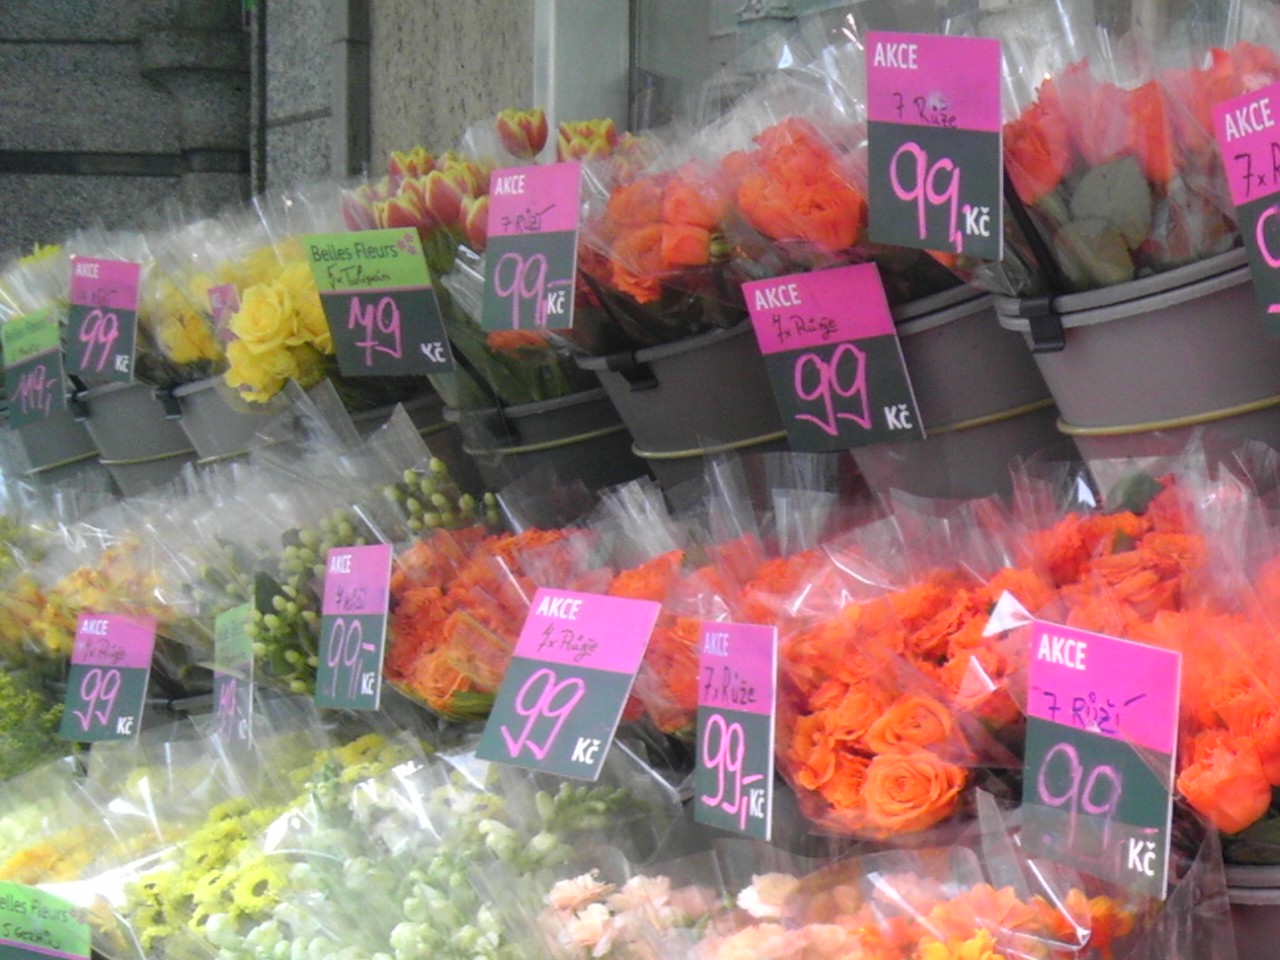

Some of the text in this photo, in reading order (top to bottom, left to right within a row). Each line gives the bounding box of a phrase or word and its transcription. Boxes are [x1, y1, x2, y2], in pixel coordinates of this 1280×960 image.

[874, 43, 918, 69] AKCE
[892, 92, 905, 118] 7
[1225, 98, 1275, 141] AKCE
[495, 175, 525, 195] AKCE
[1234, 153, 1265, 197] 7x
[966, 207, 990, 236] Kč
[311, 242, 398, 262] Belles Fleurs
[547, 291, 565, 315] Kč
[755, 284, 801, 311] AKCE
[80, 309, 119, 373] 99
[420, 342, 447, 362] Kč
[795, 343, 912, 436] 99 Kč
[330, 555, 352, 573] AKCE
[536, 596, 582, 620] AKCE
[80, 620, 109, 635] AKCE
[704, 632, 730, 656] AKCE
[1038, 634, 1087, 670] AKCE
[361, 672, 375, 695] Kč
[72, 668, 134, 735] 99 Kč
[1043, 691, 1061, 721] 7
[501, 668, 601, 765] 99 Kč
[750, 788, 765, 818] Kč
[1128, 837, 1157, 876] Kč
[0, 894, 68, 923] elles Fleurs
